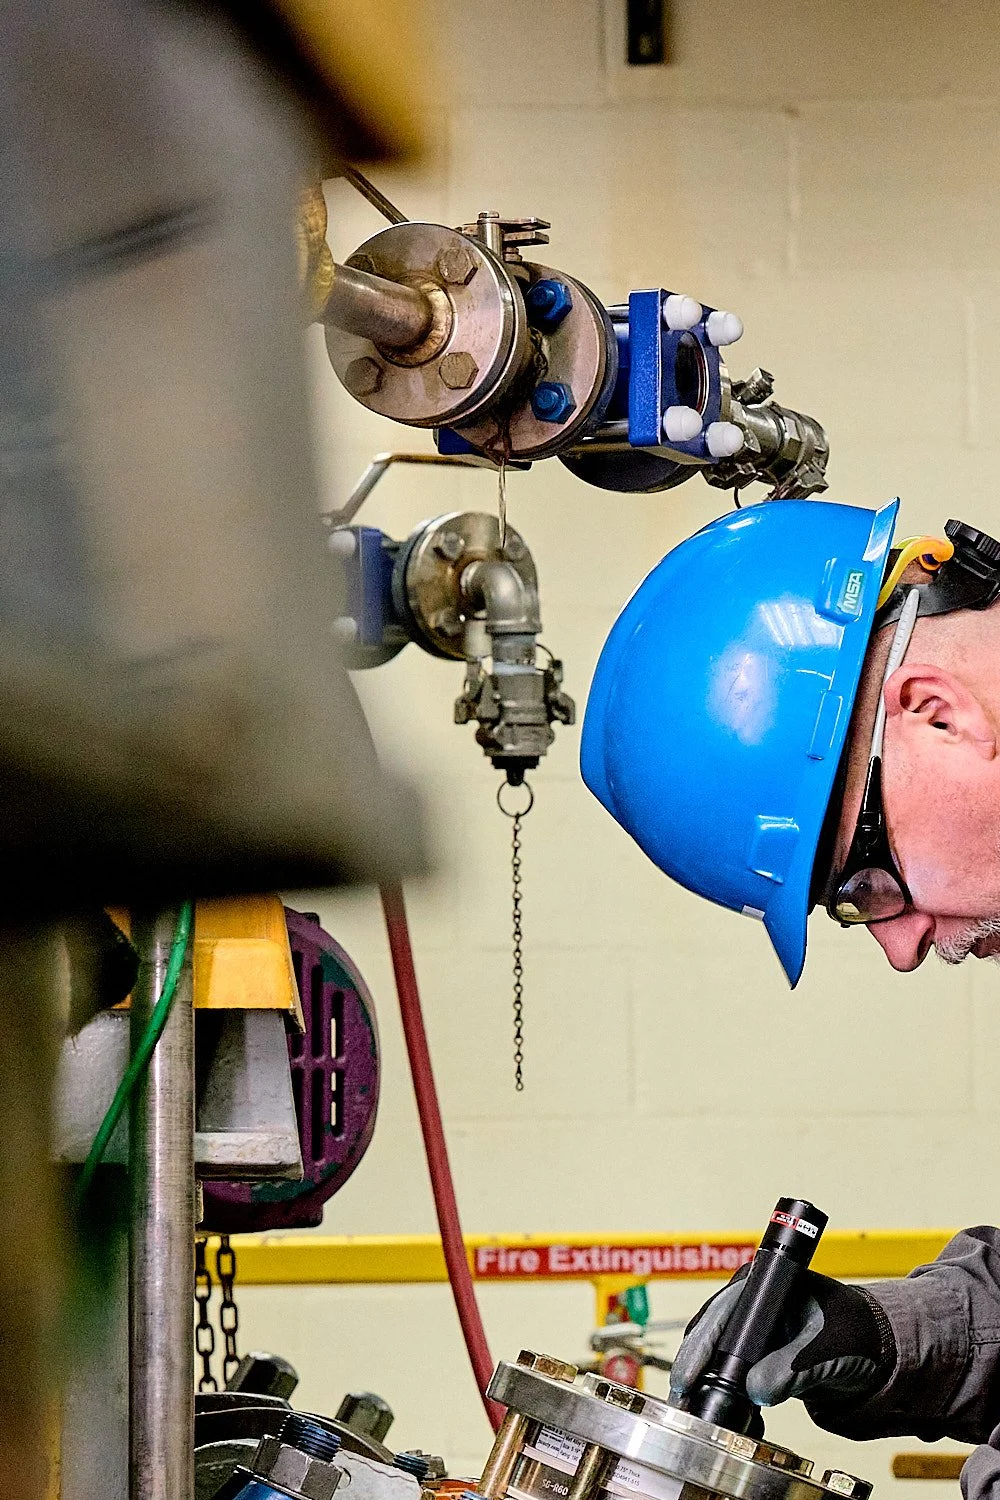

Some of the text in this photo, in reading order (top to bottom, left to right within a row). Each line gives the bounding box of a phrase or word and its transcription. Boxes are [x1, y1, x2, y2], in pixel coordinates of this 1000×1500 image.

[843, 572, 864, 610] MSA
[476, 1244, 755, 1275] Fire Extinguisher
[542, 1478, 569, 1496] SG-R60
